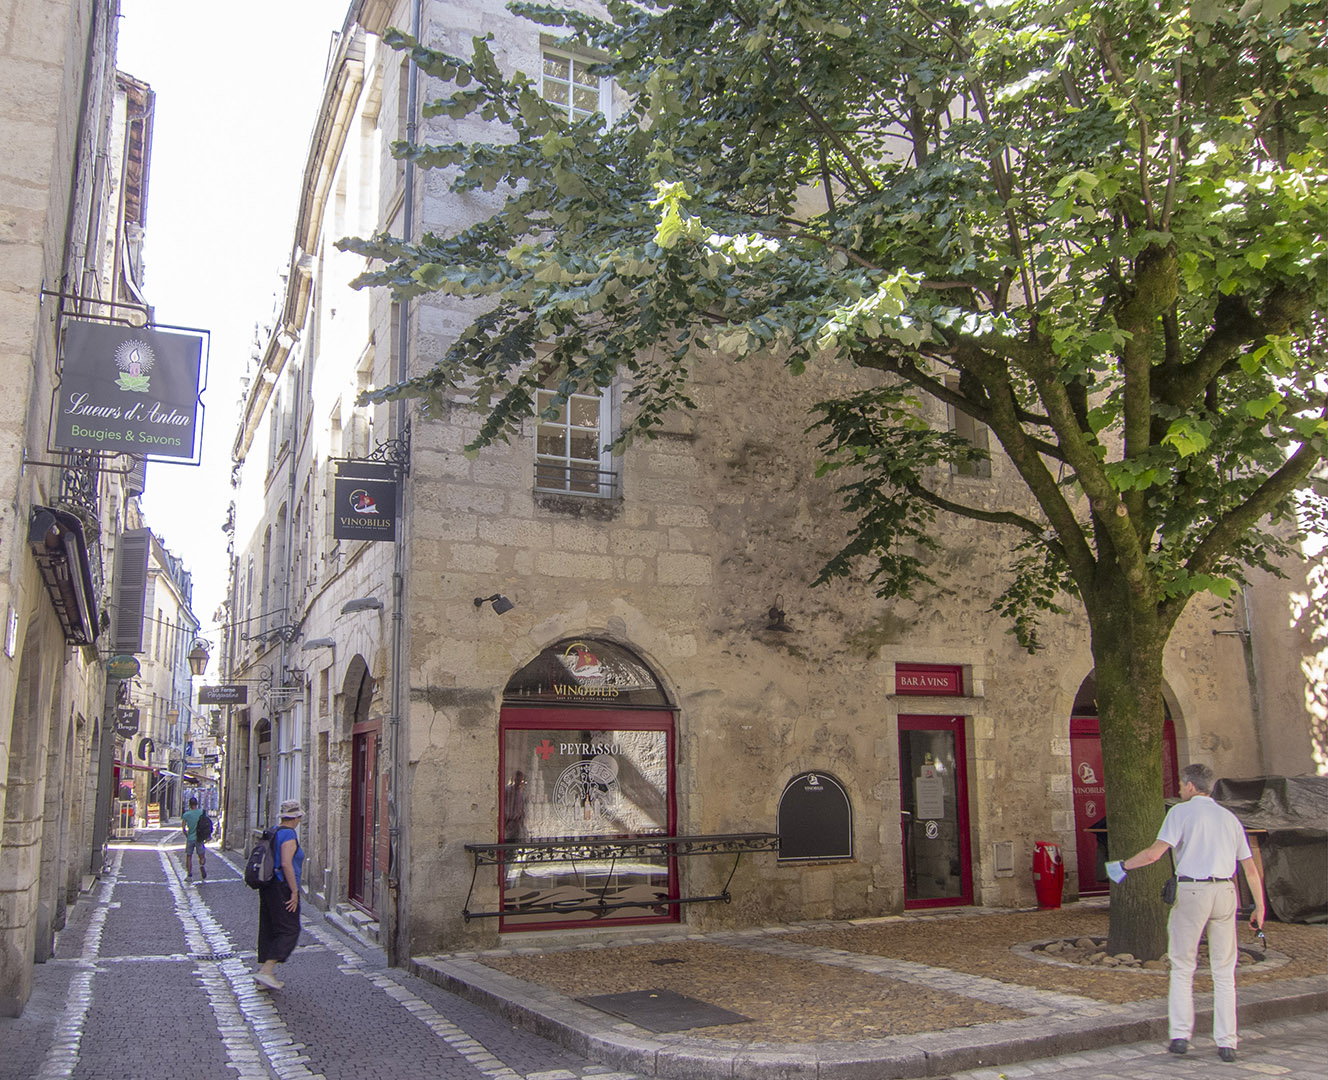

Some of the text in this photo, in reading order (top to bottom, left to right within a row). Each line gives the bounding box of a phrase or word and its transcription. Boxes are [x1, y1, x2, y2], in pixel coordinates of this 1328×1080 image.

[64, 392, 191, 426] Lueurs d'Antan
[71, 425, 181, 446] Bougies & Savons
[340, 517, 391, 527] VINOBILIS
[901, 675, 949, 687] BAR À VINS
[553, 684, 619, 697] VINOBILIS
[560, 743, 625, 756] PEYRASSOL
